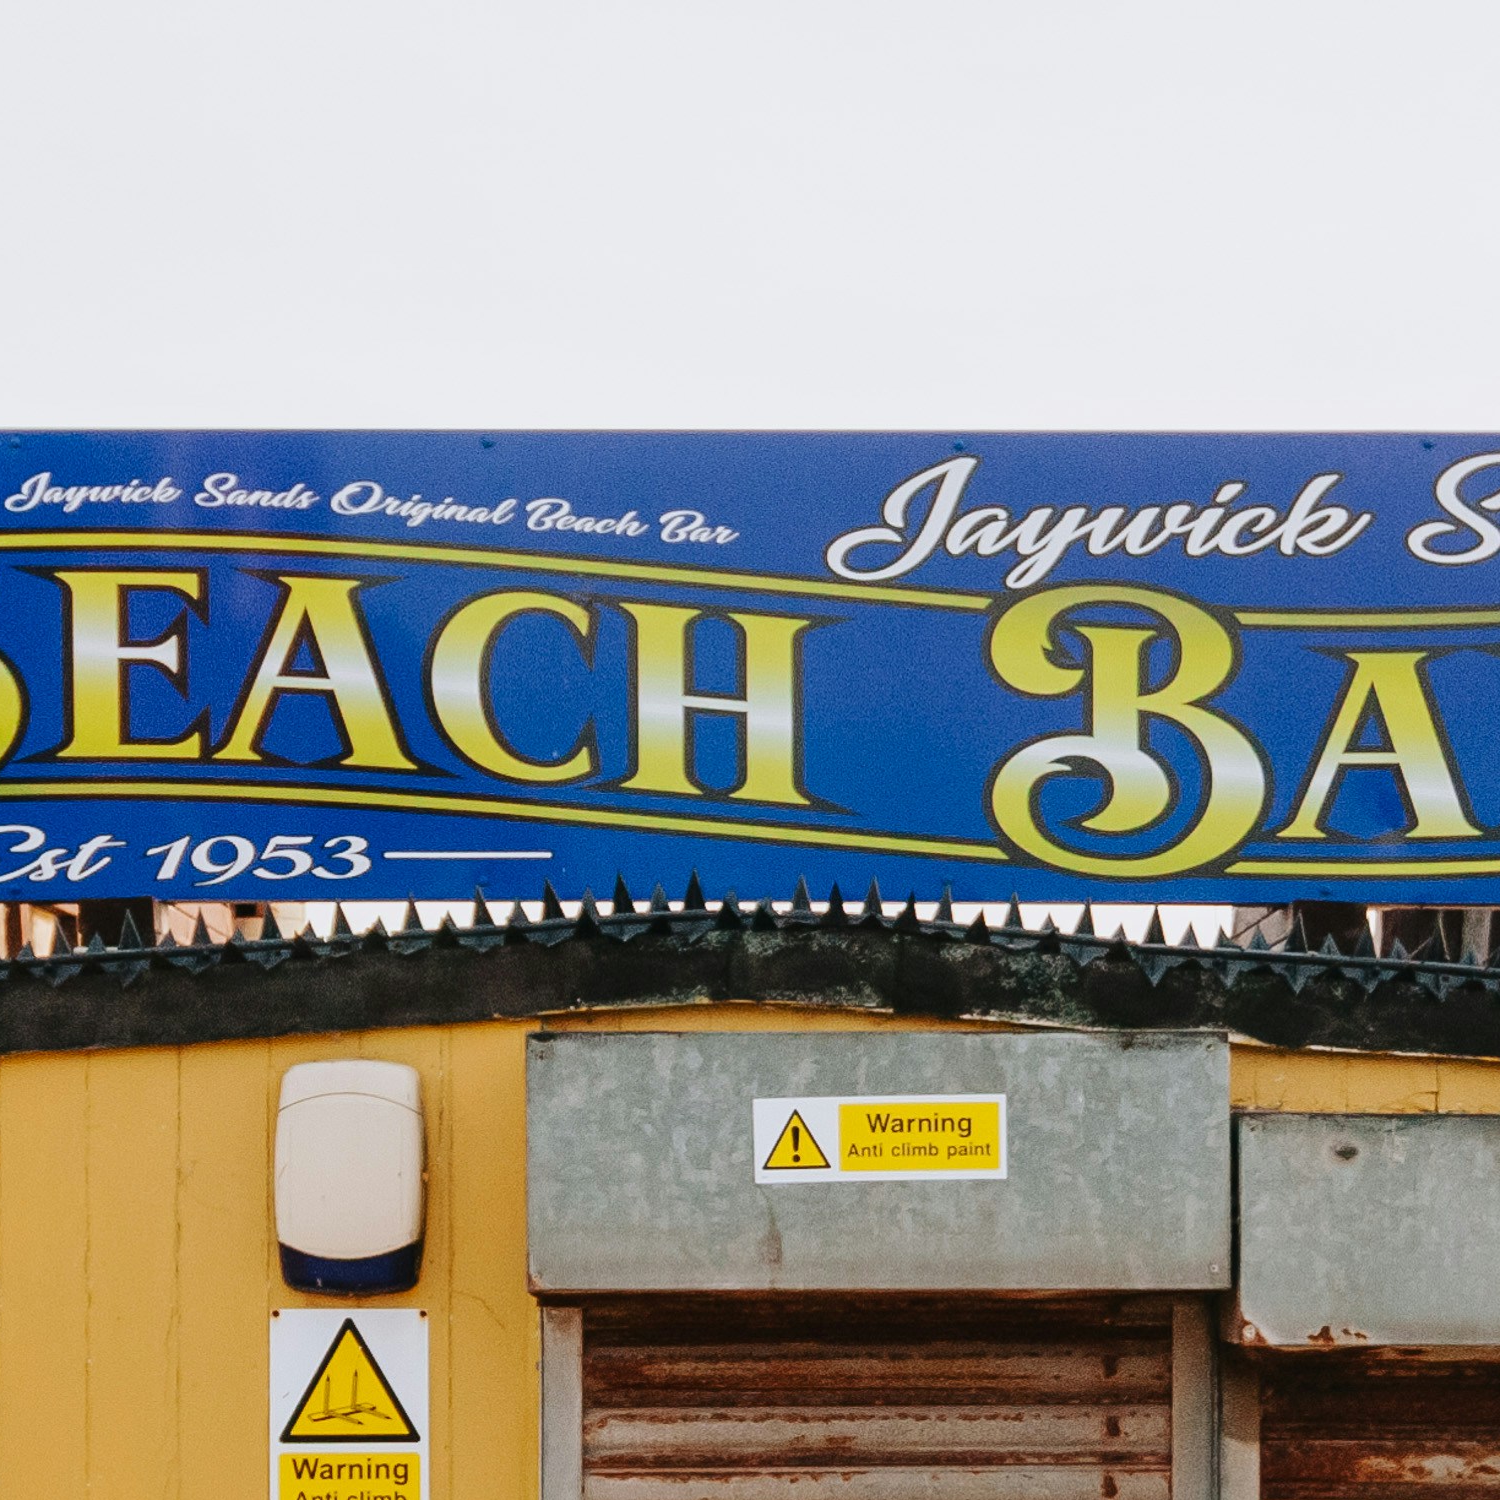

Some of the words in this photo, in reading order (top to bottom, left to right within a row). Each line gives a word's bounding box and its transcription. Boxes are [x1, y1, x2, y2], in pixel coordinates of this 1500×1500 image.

[4, 471, 183, 513] Jaywick
[194, 472, 320, 510] Sands
[330, 480, 518, 528] Original
[525, 497, 650, 537] Beach
[659, 509, 741, 545] Bar
[826, 456, 1373, 588] Jaywick
[146, 835, 372, 884] 1953
[866, 1113, 972, 1138] Warning
[847, 1143, 883, 1158] Anti
[891, 1143, 939, 1157] climb
[947, 1143, 991, 1159] paint
[292, 1457, 409, 1485] Warning
